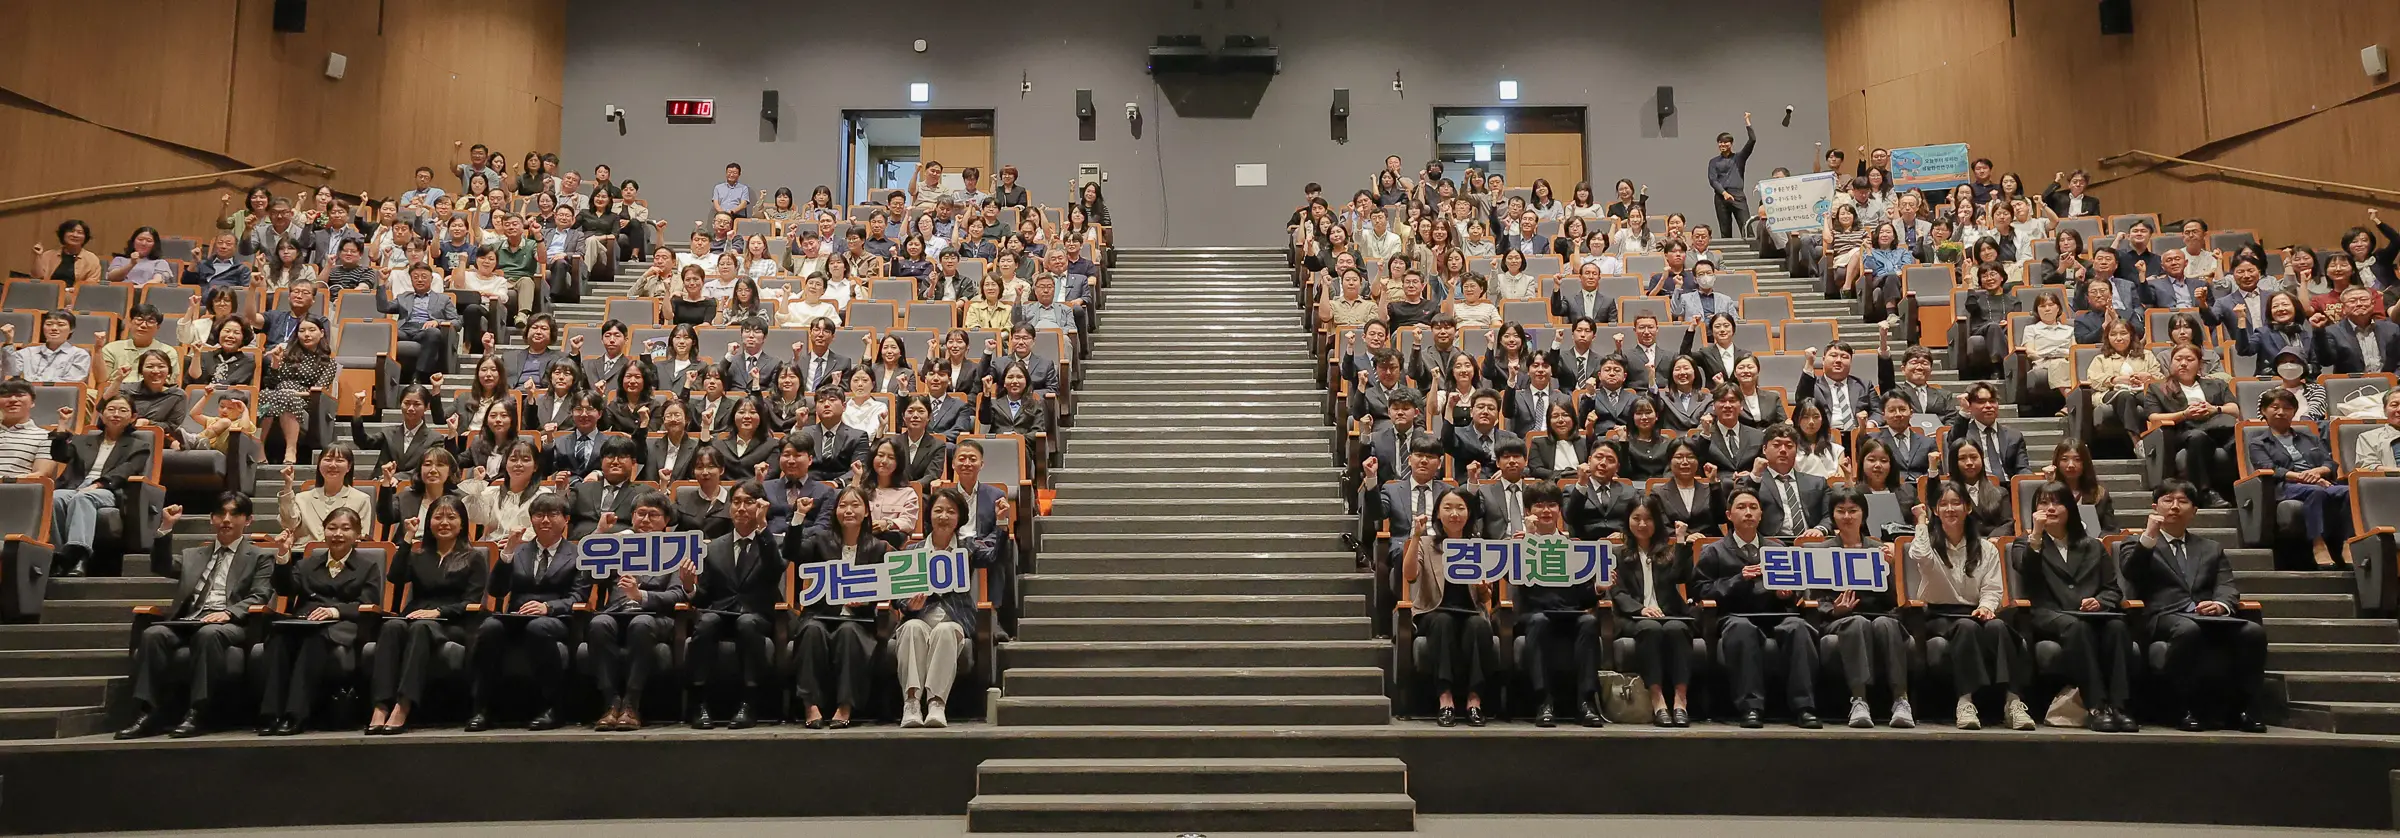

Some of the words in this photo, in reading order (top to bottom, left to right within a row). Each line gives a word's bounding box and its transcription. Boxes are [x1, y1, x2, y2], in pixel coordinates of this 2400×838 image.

[582, 535, 702, 575] 우리가
[804, 563, 877, 599] 가는
[888, 551, 966, 595] 길이
[1446, 537, 1612, 583] 경기道가
[1764, 550, 1885, 588] 됩니다
